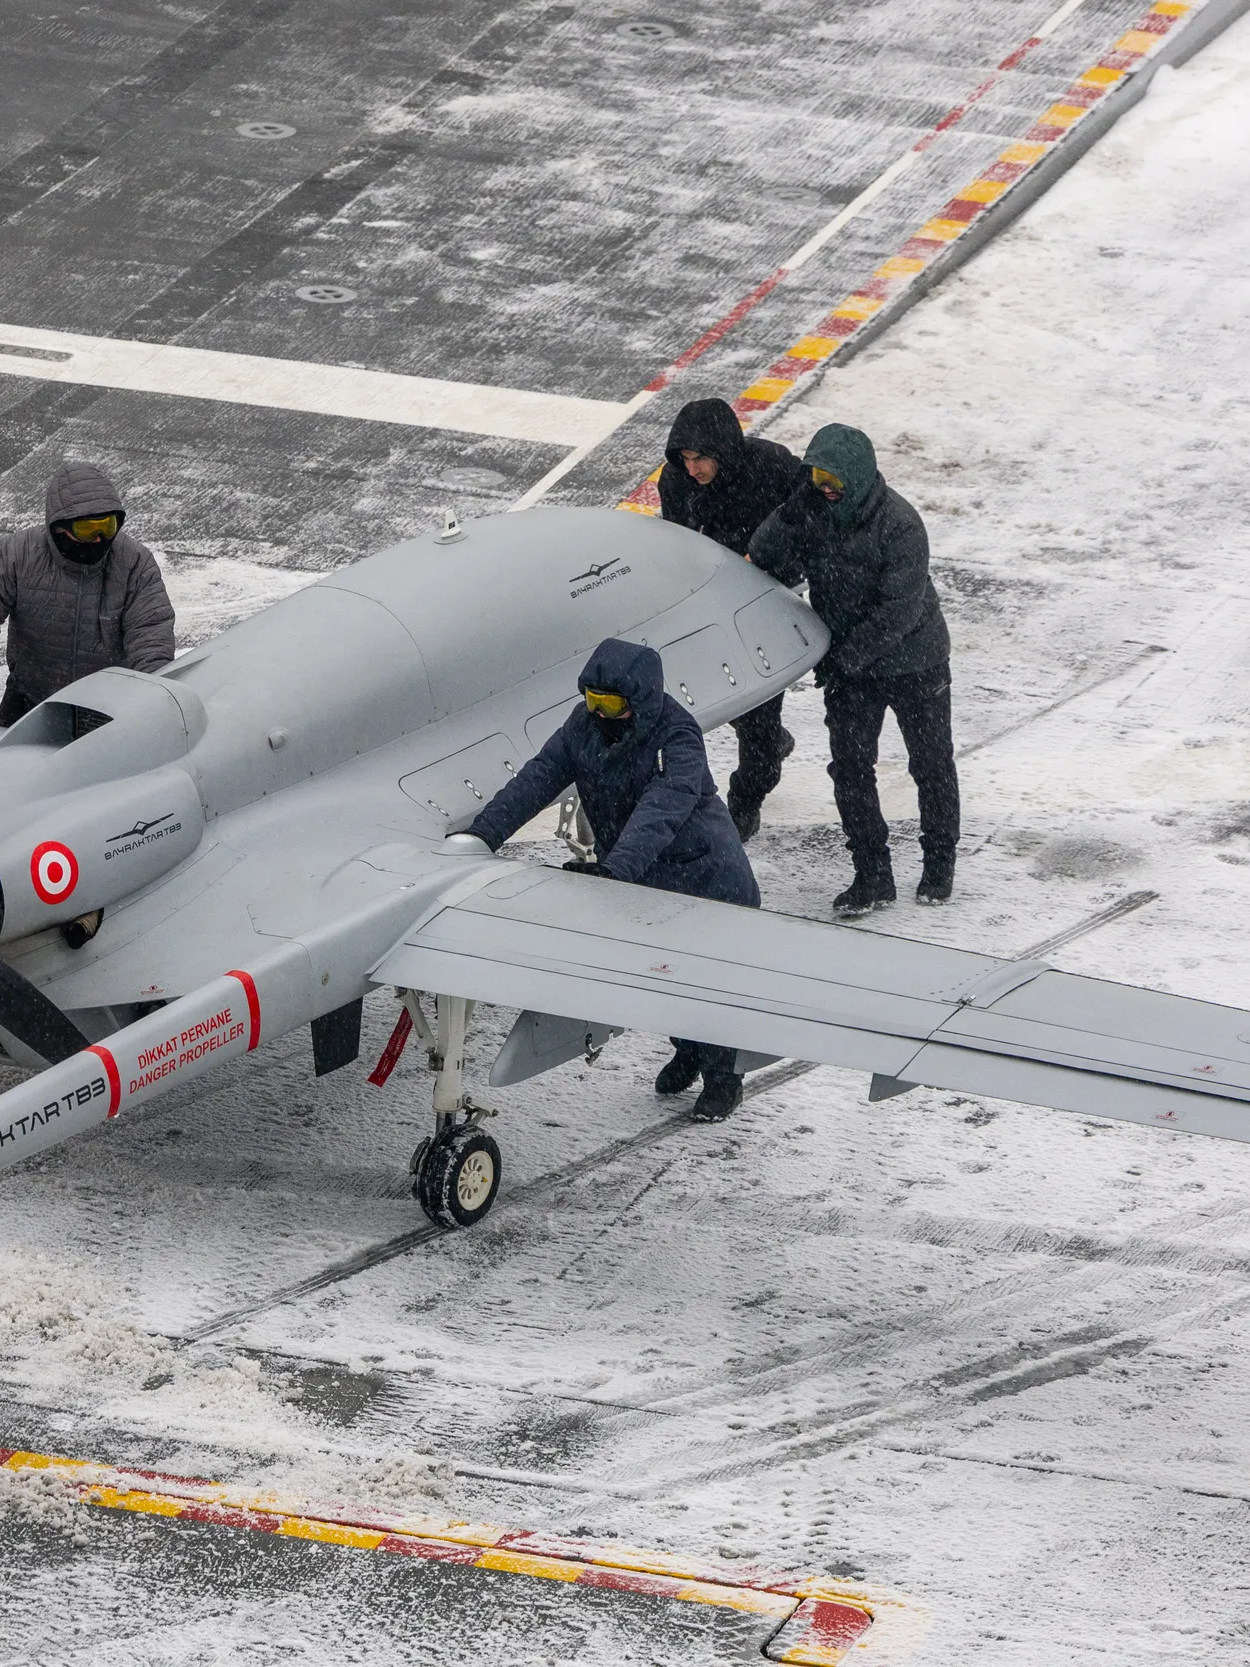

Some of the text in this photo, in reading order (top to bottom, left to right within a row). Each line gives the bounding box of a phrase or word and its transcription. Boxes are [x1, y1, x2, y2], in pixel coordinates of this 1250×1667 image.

[129, 1022, 245, 1095] DANGER PROPELLER
[137, 1008, 233, 1070] DİKKAT PERVANE
